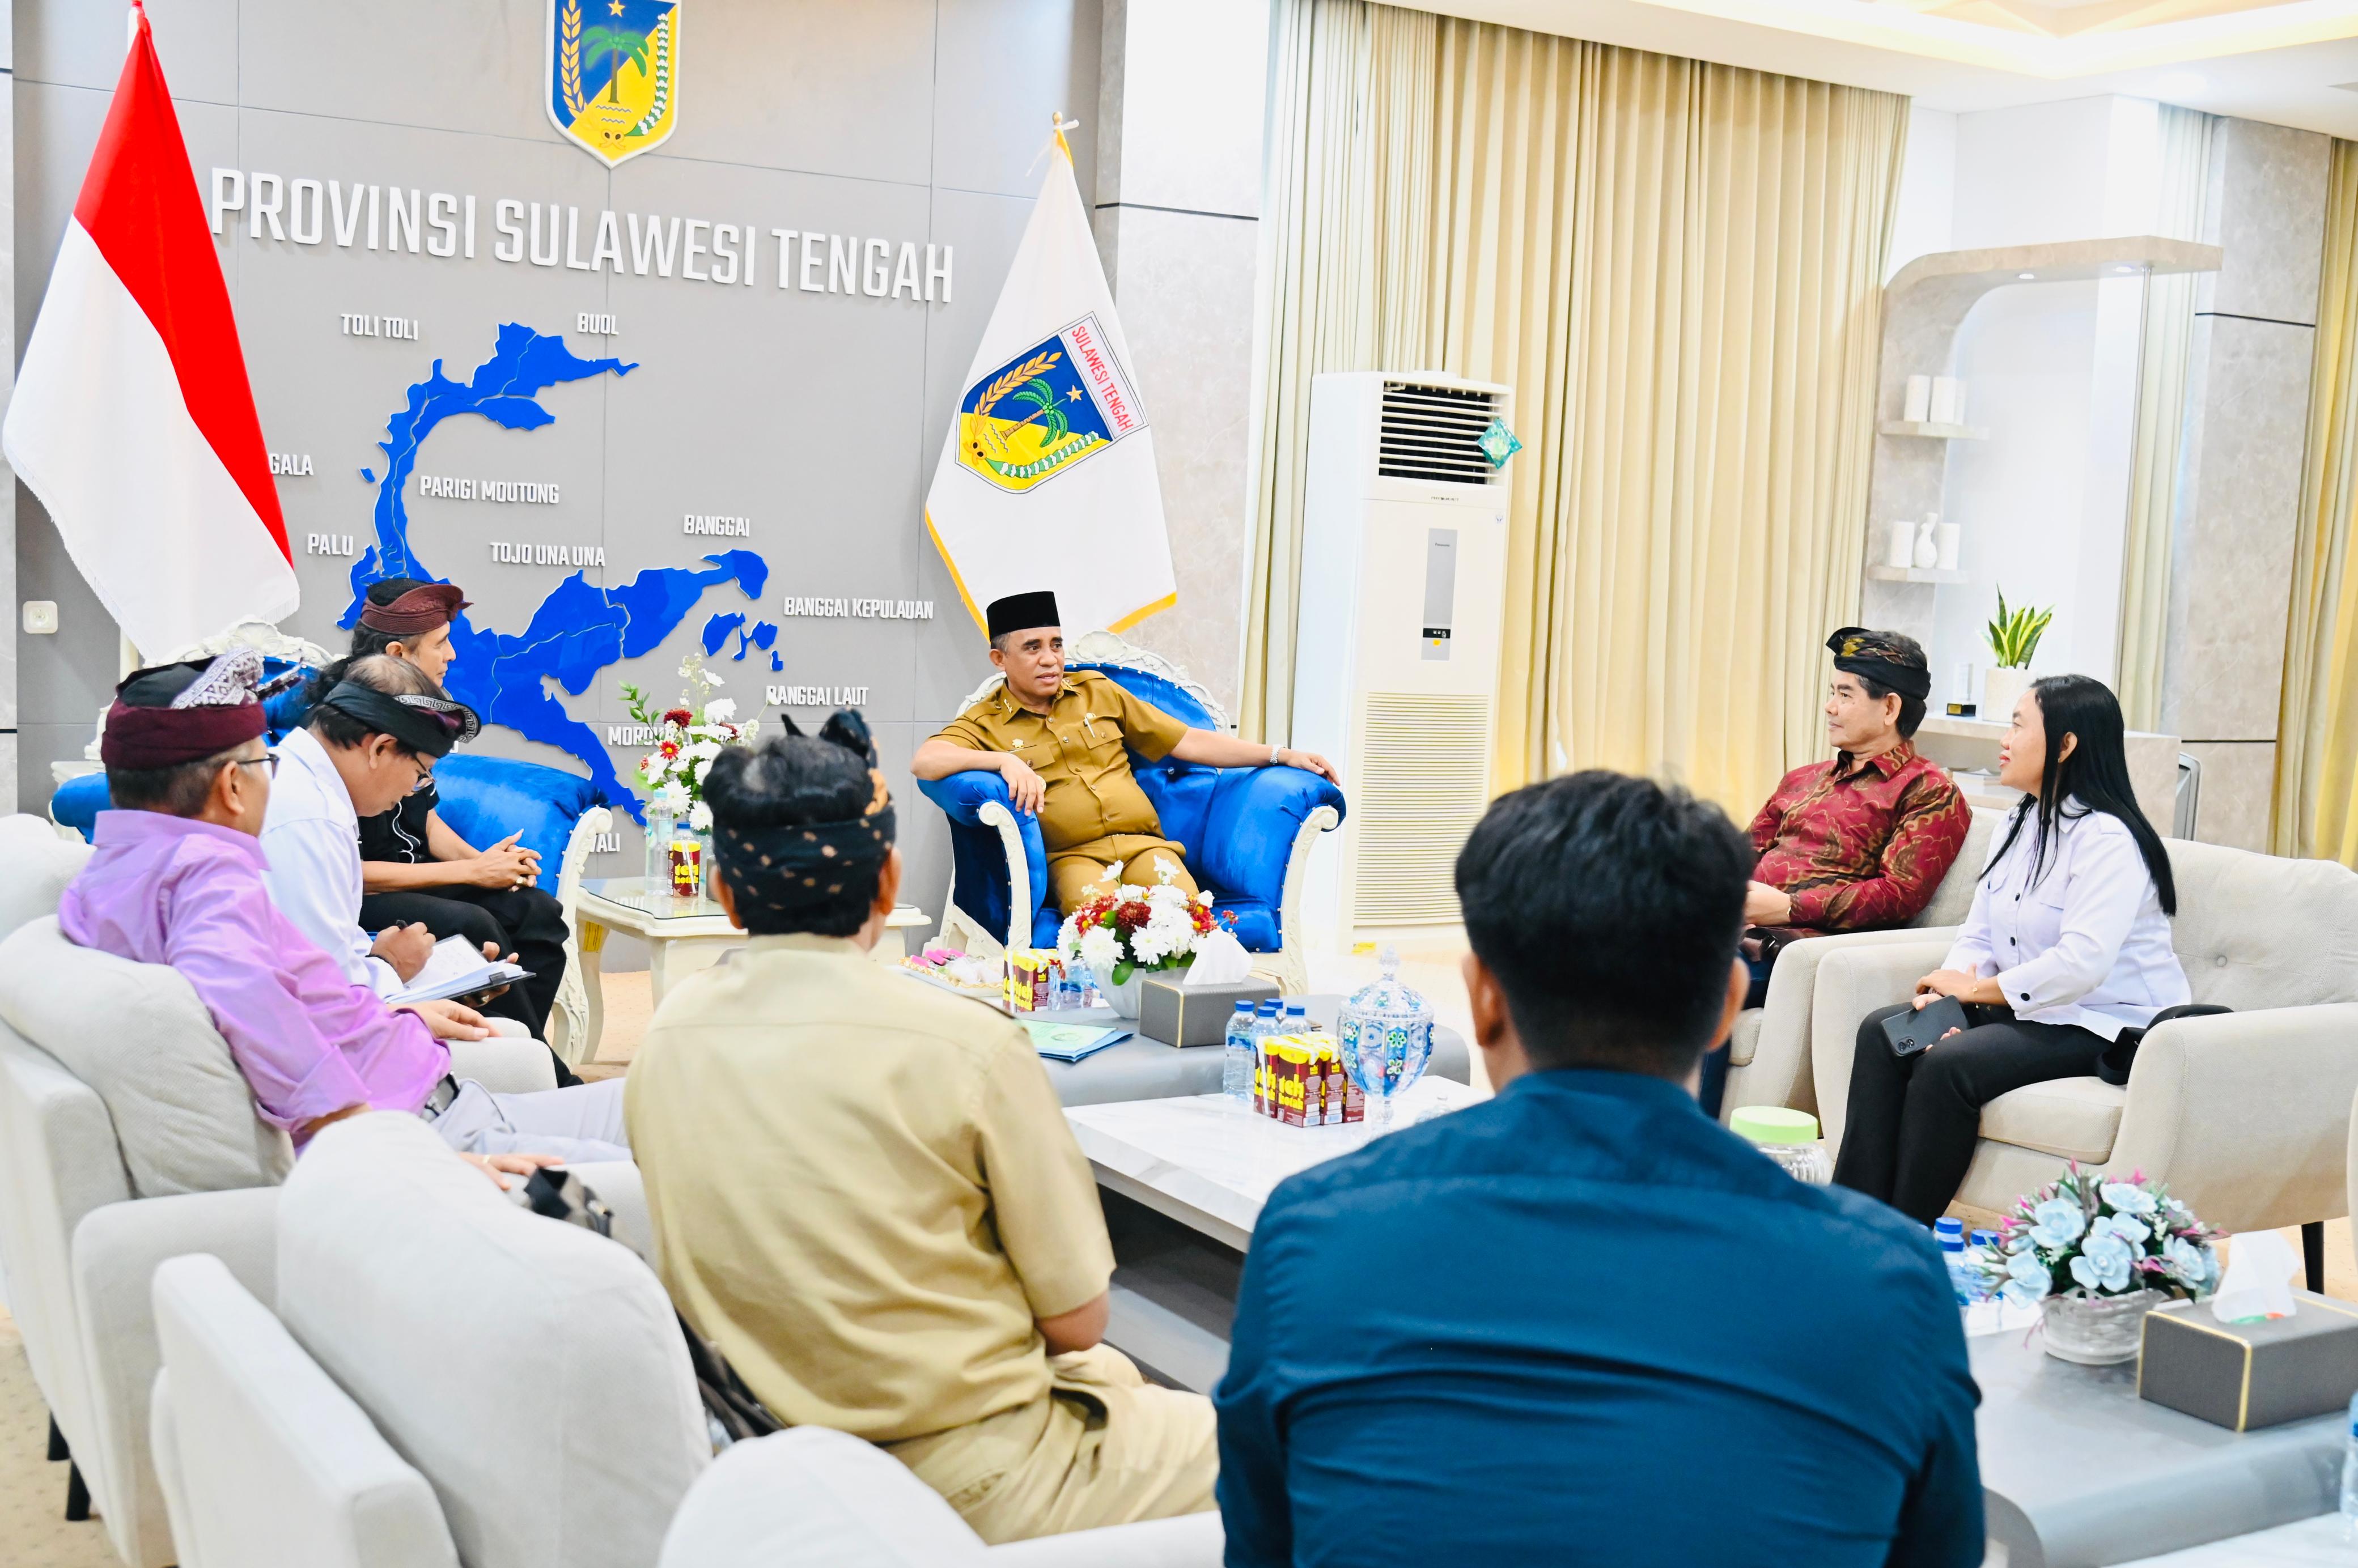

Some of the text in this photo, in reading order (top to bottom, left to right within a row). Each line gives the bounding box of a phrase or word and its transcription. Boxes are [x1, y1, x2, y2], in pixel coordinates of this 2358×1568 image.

[212, 168, 953, 303] PROVINSI SULAWESI TENGAH
[341, 313, 418, 340] TOLI TOLI
[577, 312, 619, 335] BUOL
[1072, 326, 1134, 431] SULAWESI TENGAH
[420, 475, 559, 504] PARIGI MOUTONG
[684, 515, 750, 537] BANGGAI
[307, 533, 354, 555] PALU
[490, 542, 605, 566] TOJO UNA UNA
[784, 597, 934, 619] BANGGAI KEPULAUAN
[766, 685, 869, 706] BANGGAI LAUT
[1279, 1074, 1304, 1099] teh
